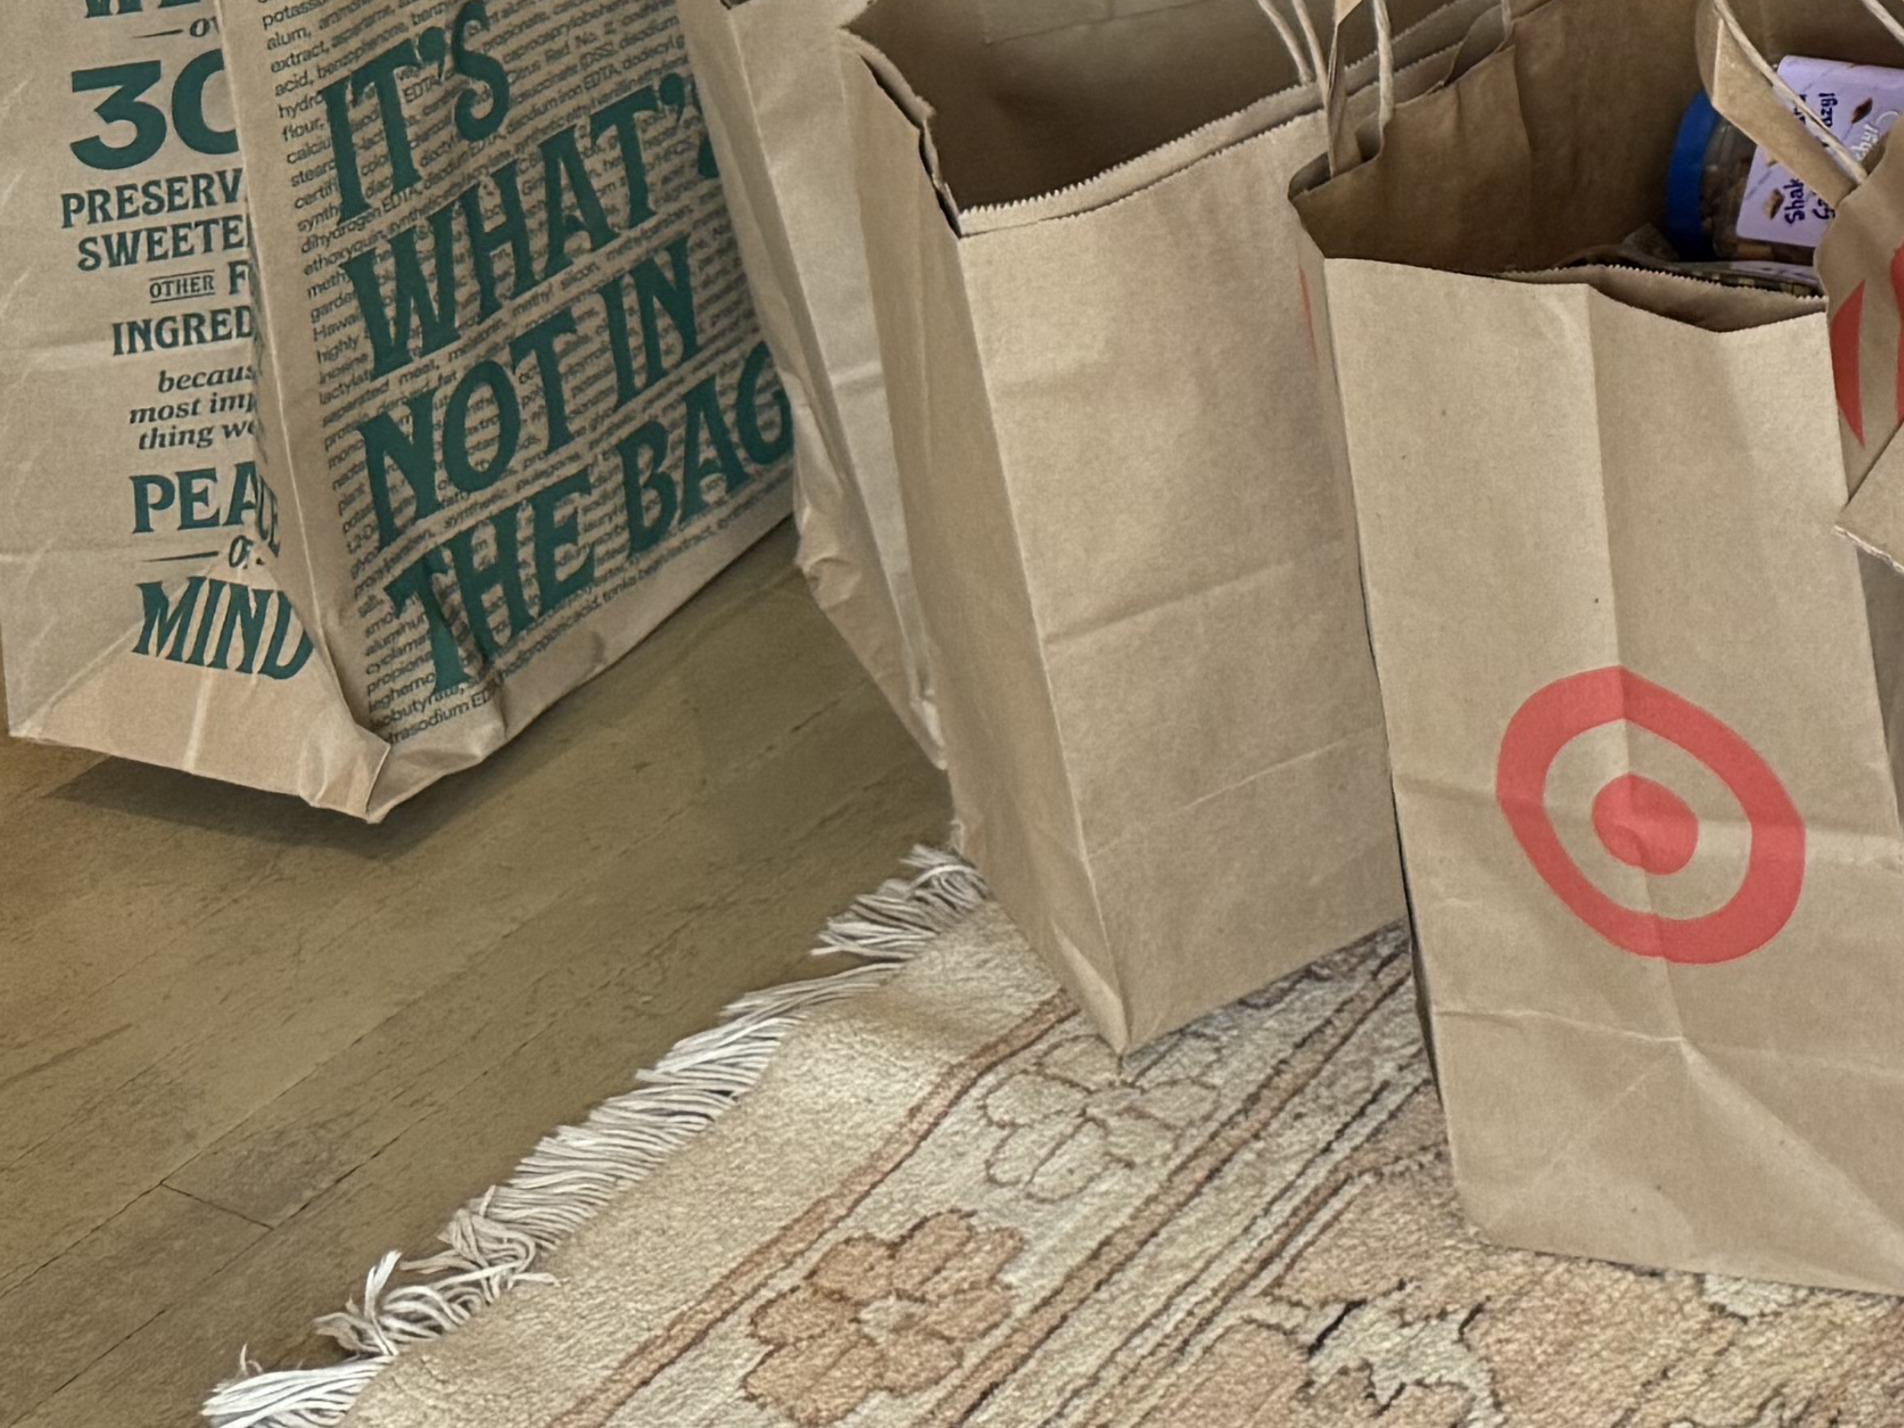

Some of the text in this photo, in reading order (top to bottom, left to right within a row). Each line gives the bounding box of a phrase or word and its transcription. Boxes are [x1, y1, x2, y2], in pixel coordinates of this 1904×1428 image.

[60, 168, 244, 229] PRESERV
[343, 73, 705, 379] WHAT'
[76, 212, 252, 274] SWEETE
[149, 274, 215, 301] OTHER
[111, 305, 255, 357] INGRED
[158, 365, 255, 394] becaus
[357, 235, 700, 548] NOT IN
[128, 397, 198, 426] most
[137, 425, 213, 452] thing
[385, 341, 794, 696] THE BAG
[132, 575, 317, 683] MIND
